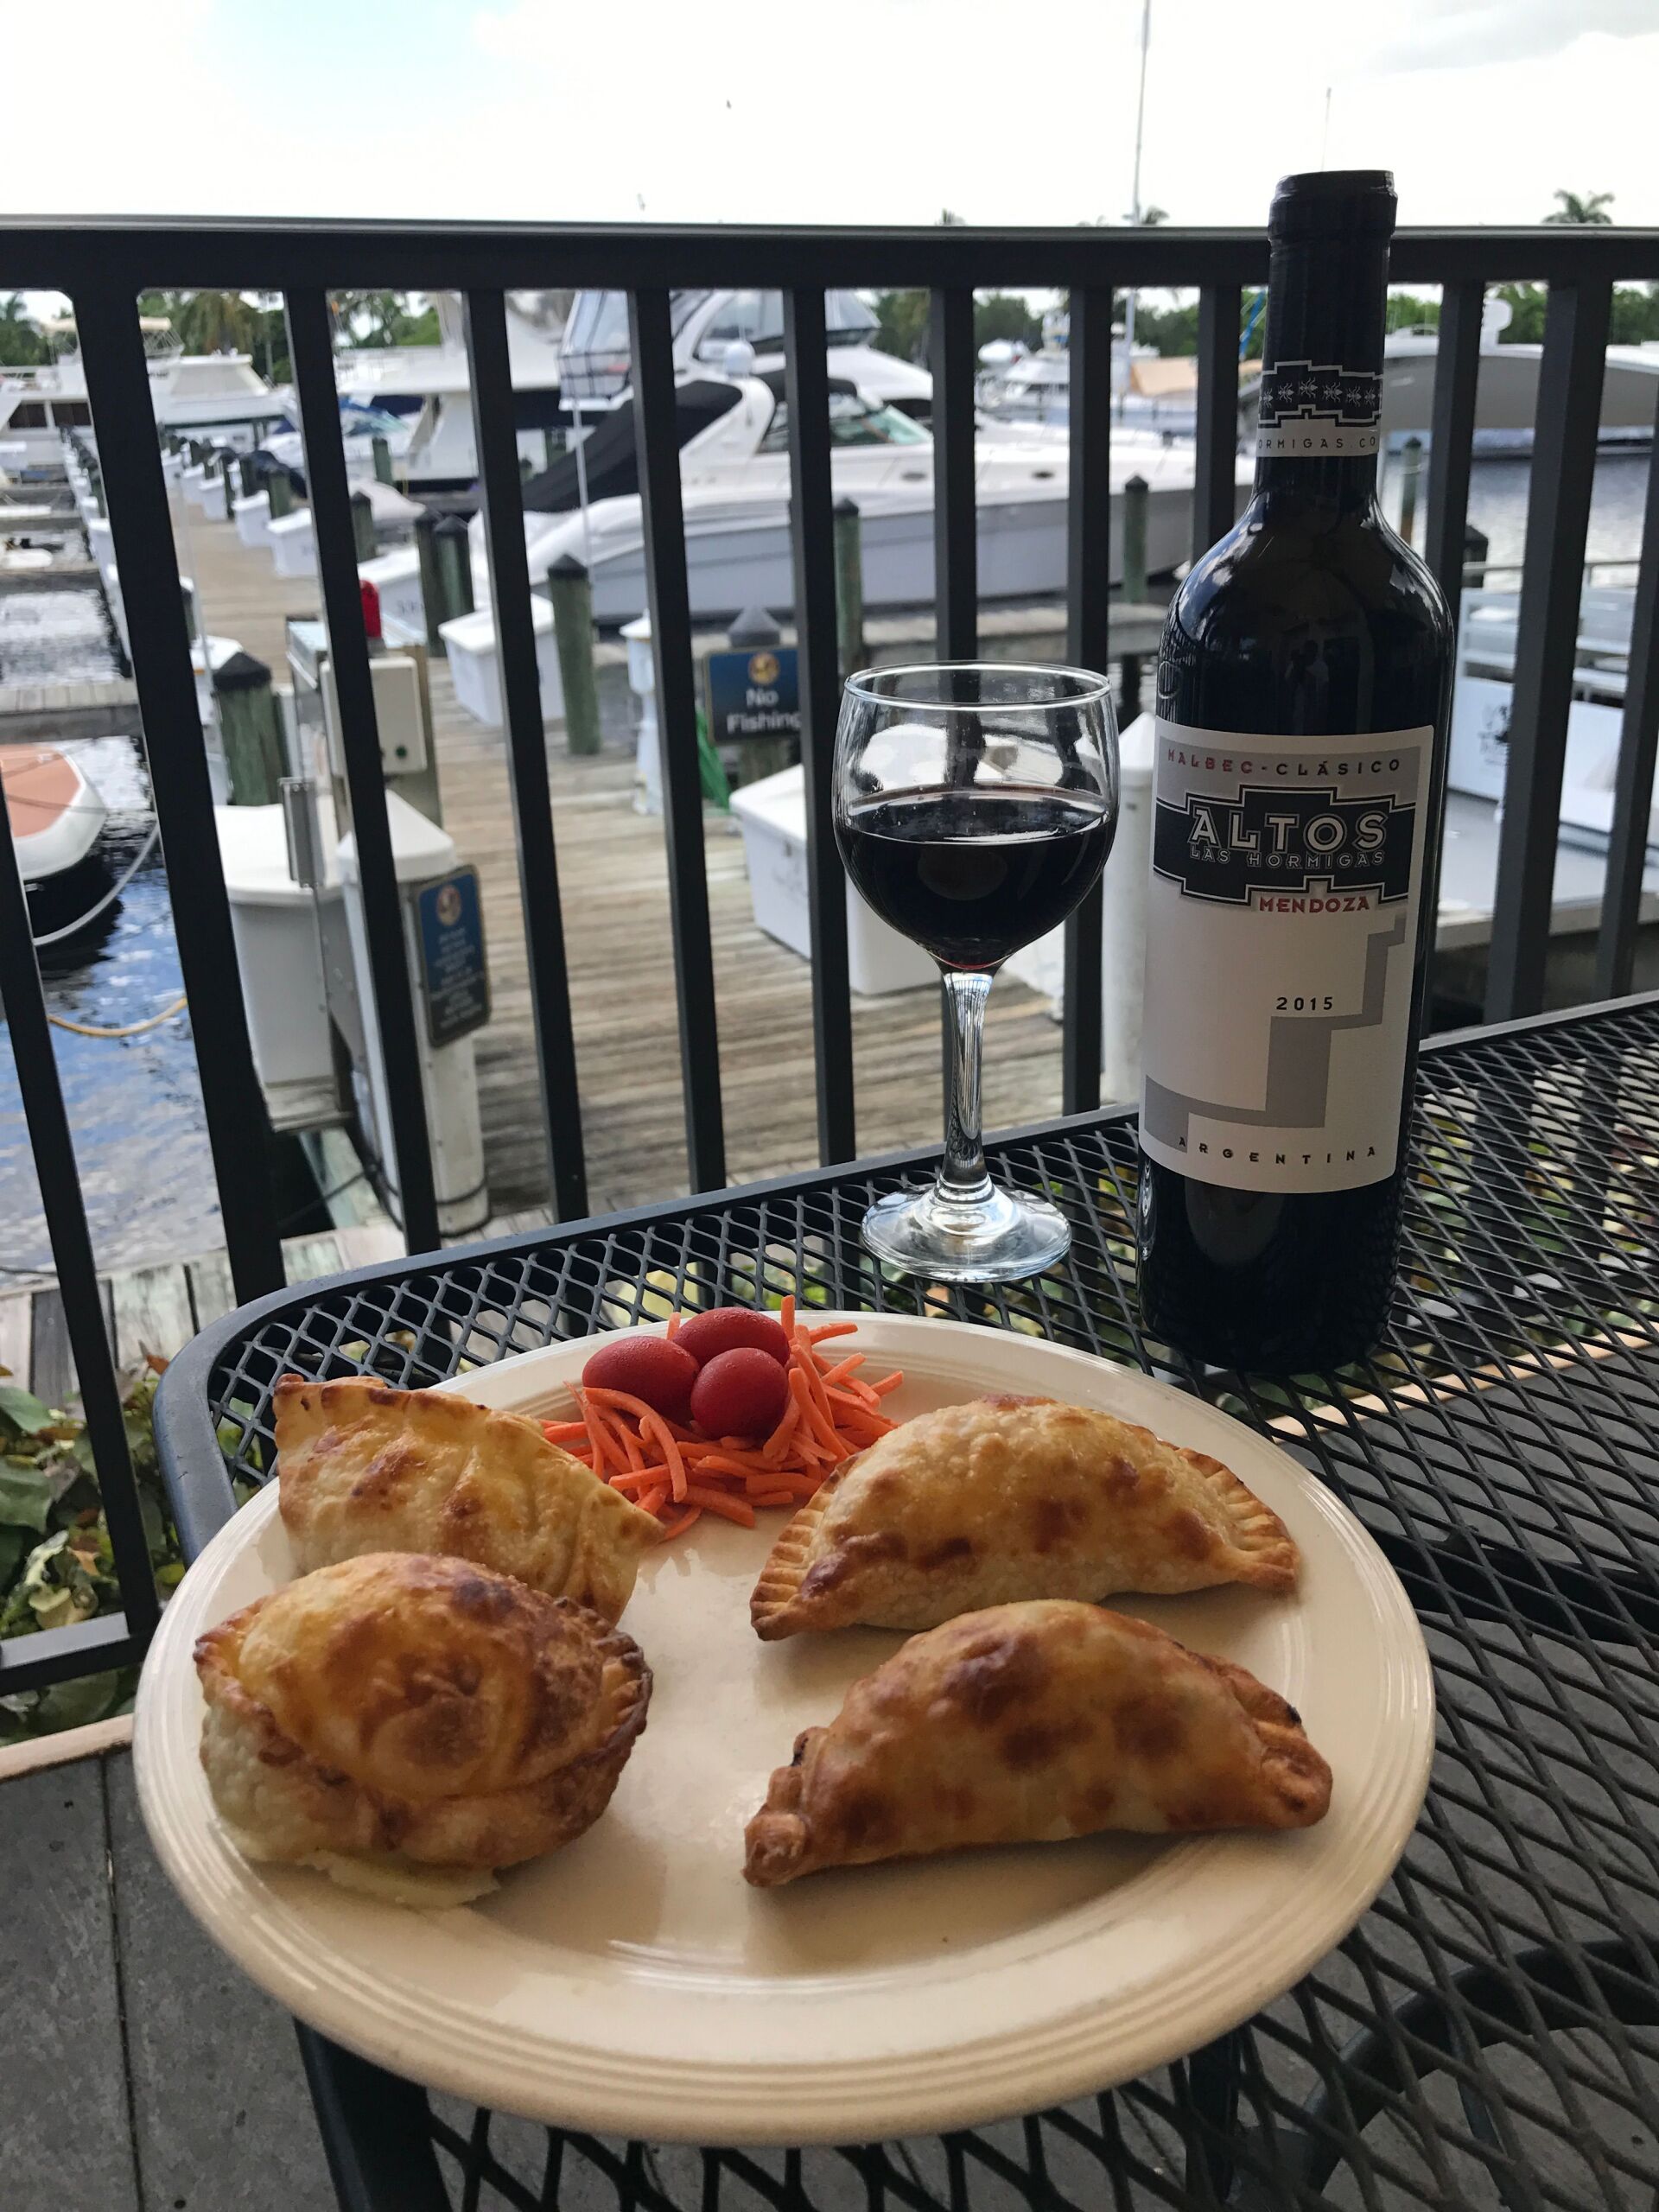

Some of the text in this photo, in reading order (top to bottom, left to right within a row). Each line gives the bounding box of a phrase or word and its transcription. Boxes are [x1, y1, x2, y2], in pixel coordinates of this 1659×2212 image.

[746, 689, 779, 707] No
[1187, 805, 1389, 854] ALTOS
[1189, 844, 1386, 869] LAS HORMIGAS
[1259, 896, 1370, 914] MENDOZA
[1276, 996, 1334, 1012] 2015
[1179, 1136, 1376, 1166] ARGENTINA
